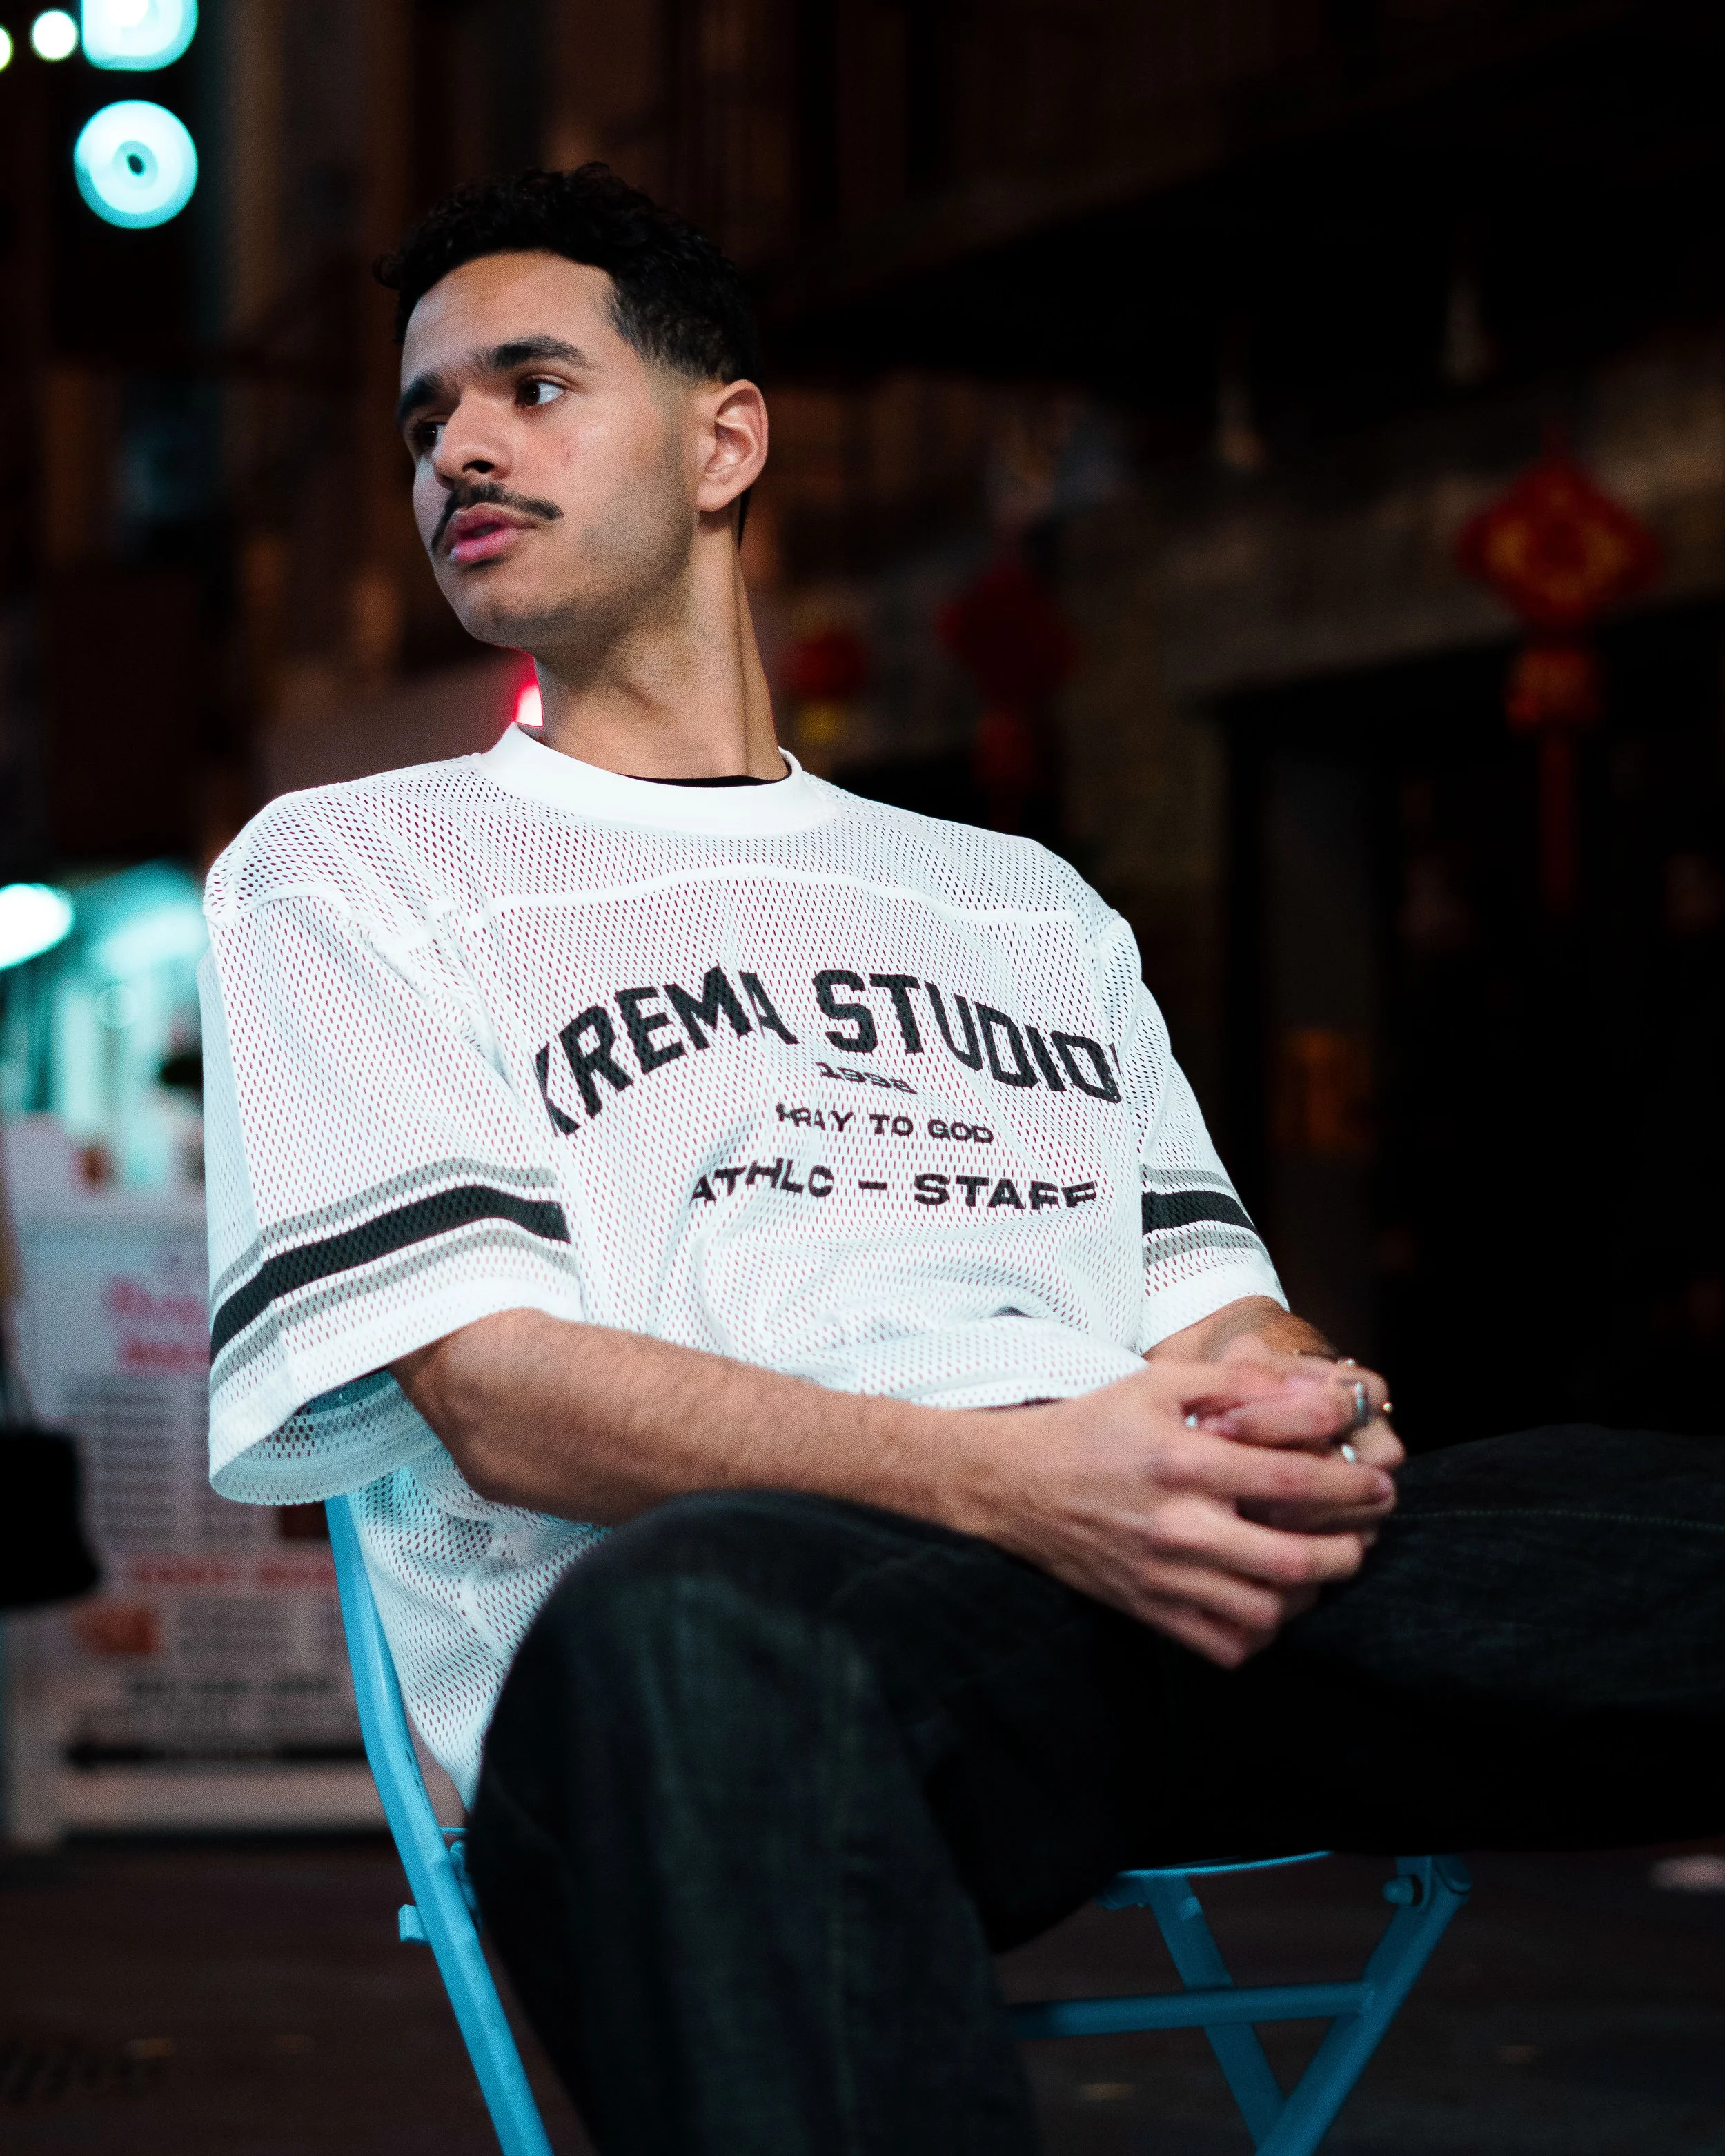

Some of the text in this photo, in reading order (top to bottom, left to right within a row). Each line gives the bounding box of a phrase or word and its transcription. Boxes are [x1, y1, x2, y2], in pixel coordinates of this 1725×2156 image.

[869, 1114, 914, 1136] TO
[927, 1119, 994, 1143] GOD
[914, 1174, 1097, 1211] STAFF
